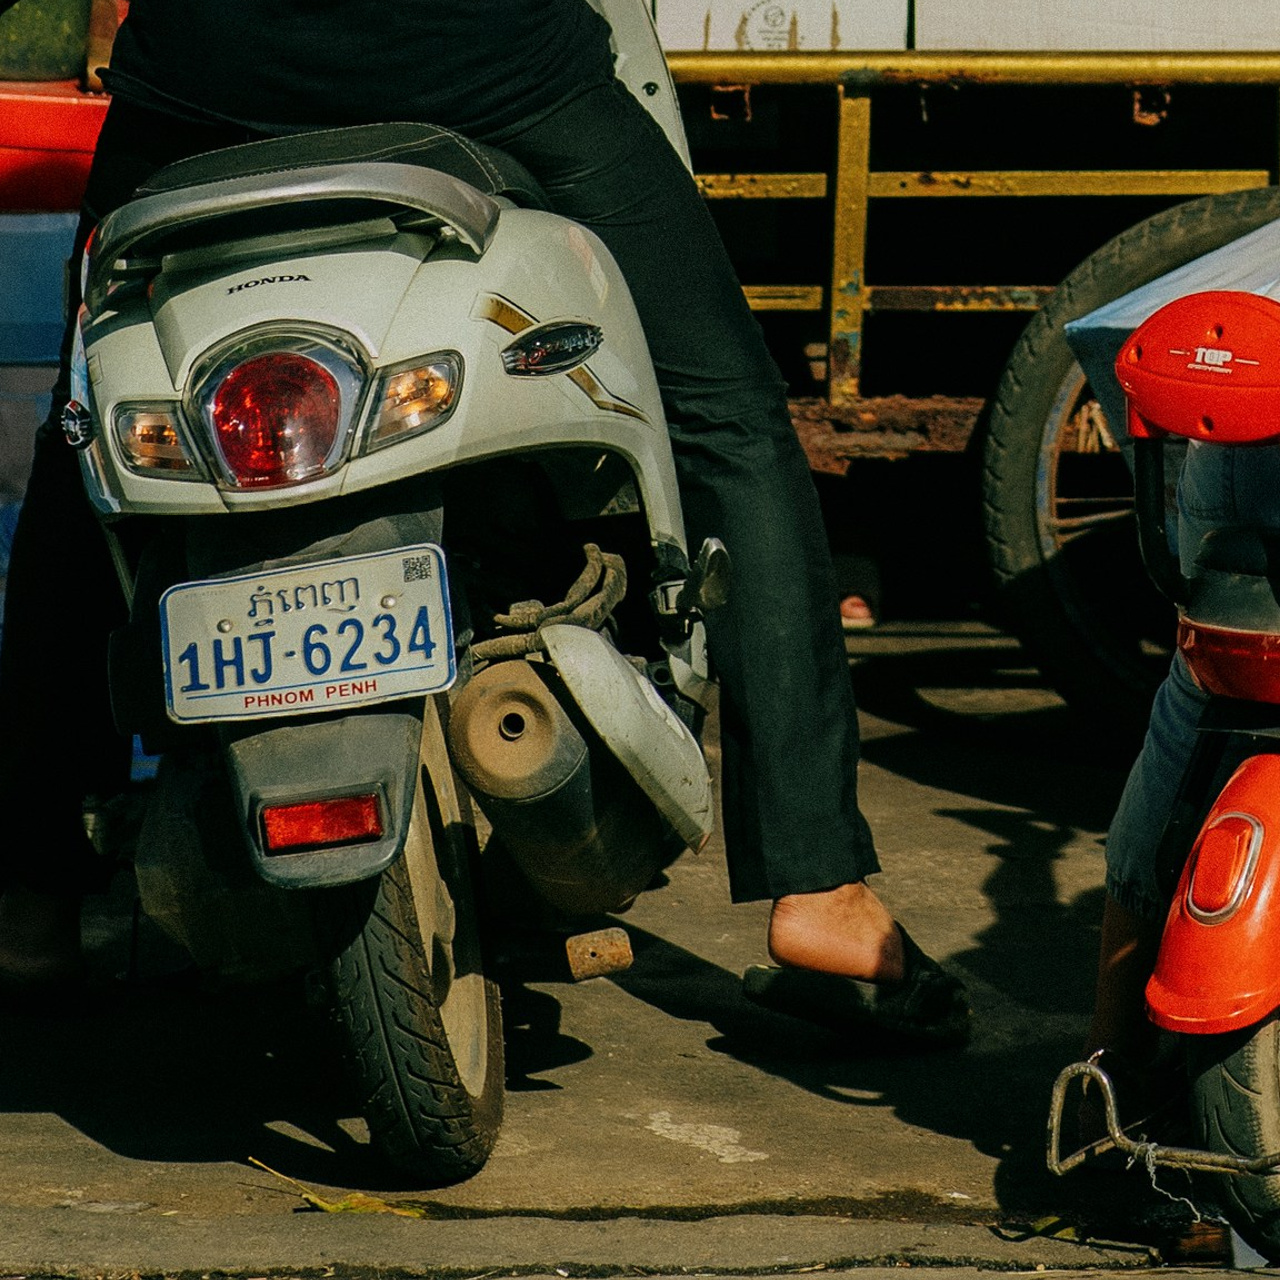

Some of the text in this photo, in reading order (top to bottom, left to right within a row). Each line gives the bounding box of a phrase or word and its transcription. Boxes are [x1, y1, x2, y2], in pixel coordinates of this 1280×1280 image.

[227, 275, 311, 295] HONDA
[248, 577, 360, 627] ភ្នំពេញ
[179, 605, 436, 693] 1HJ-6234
[244, 680, 378, 709] PHNOM PENH
